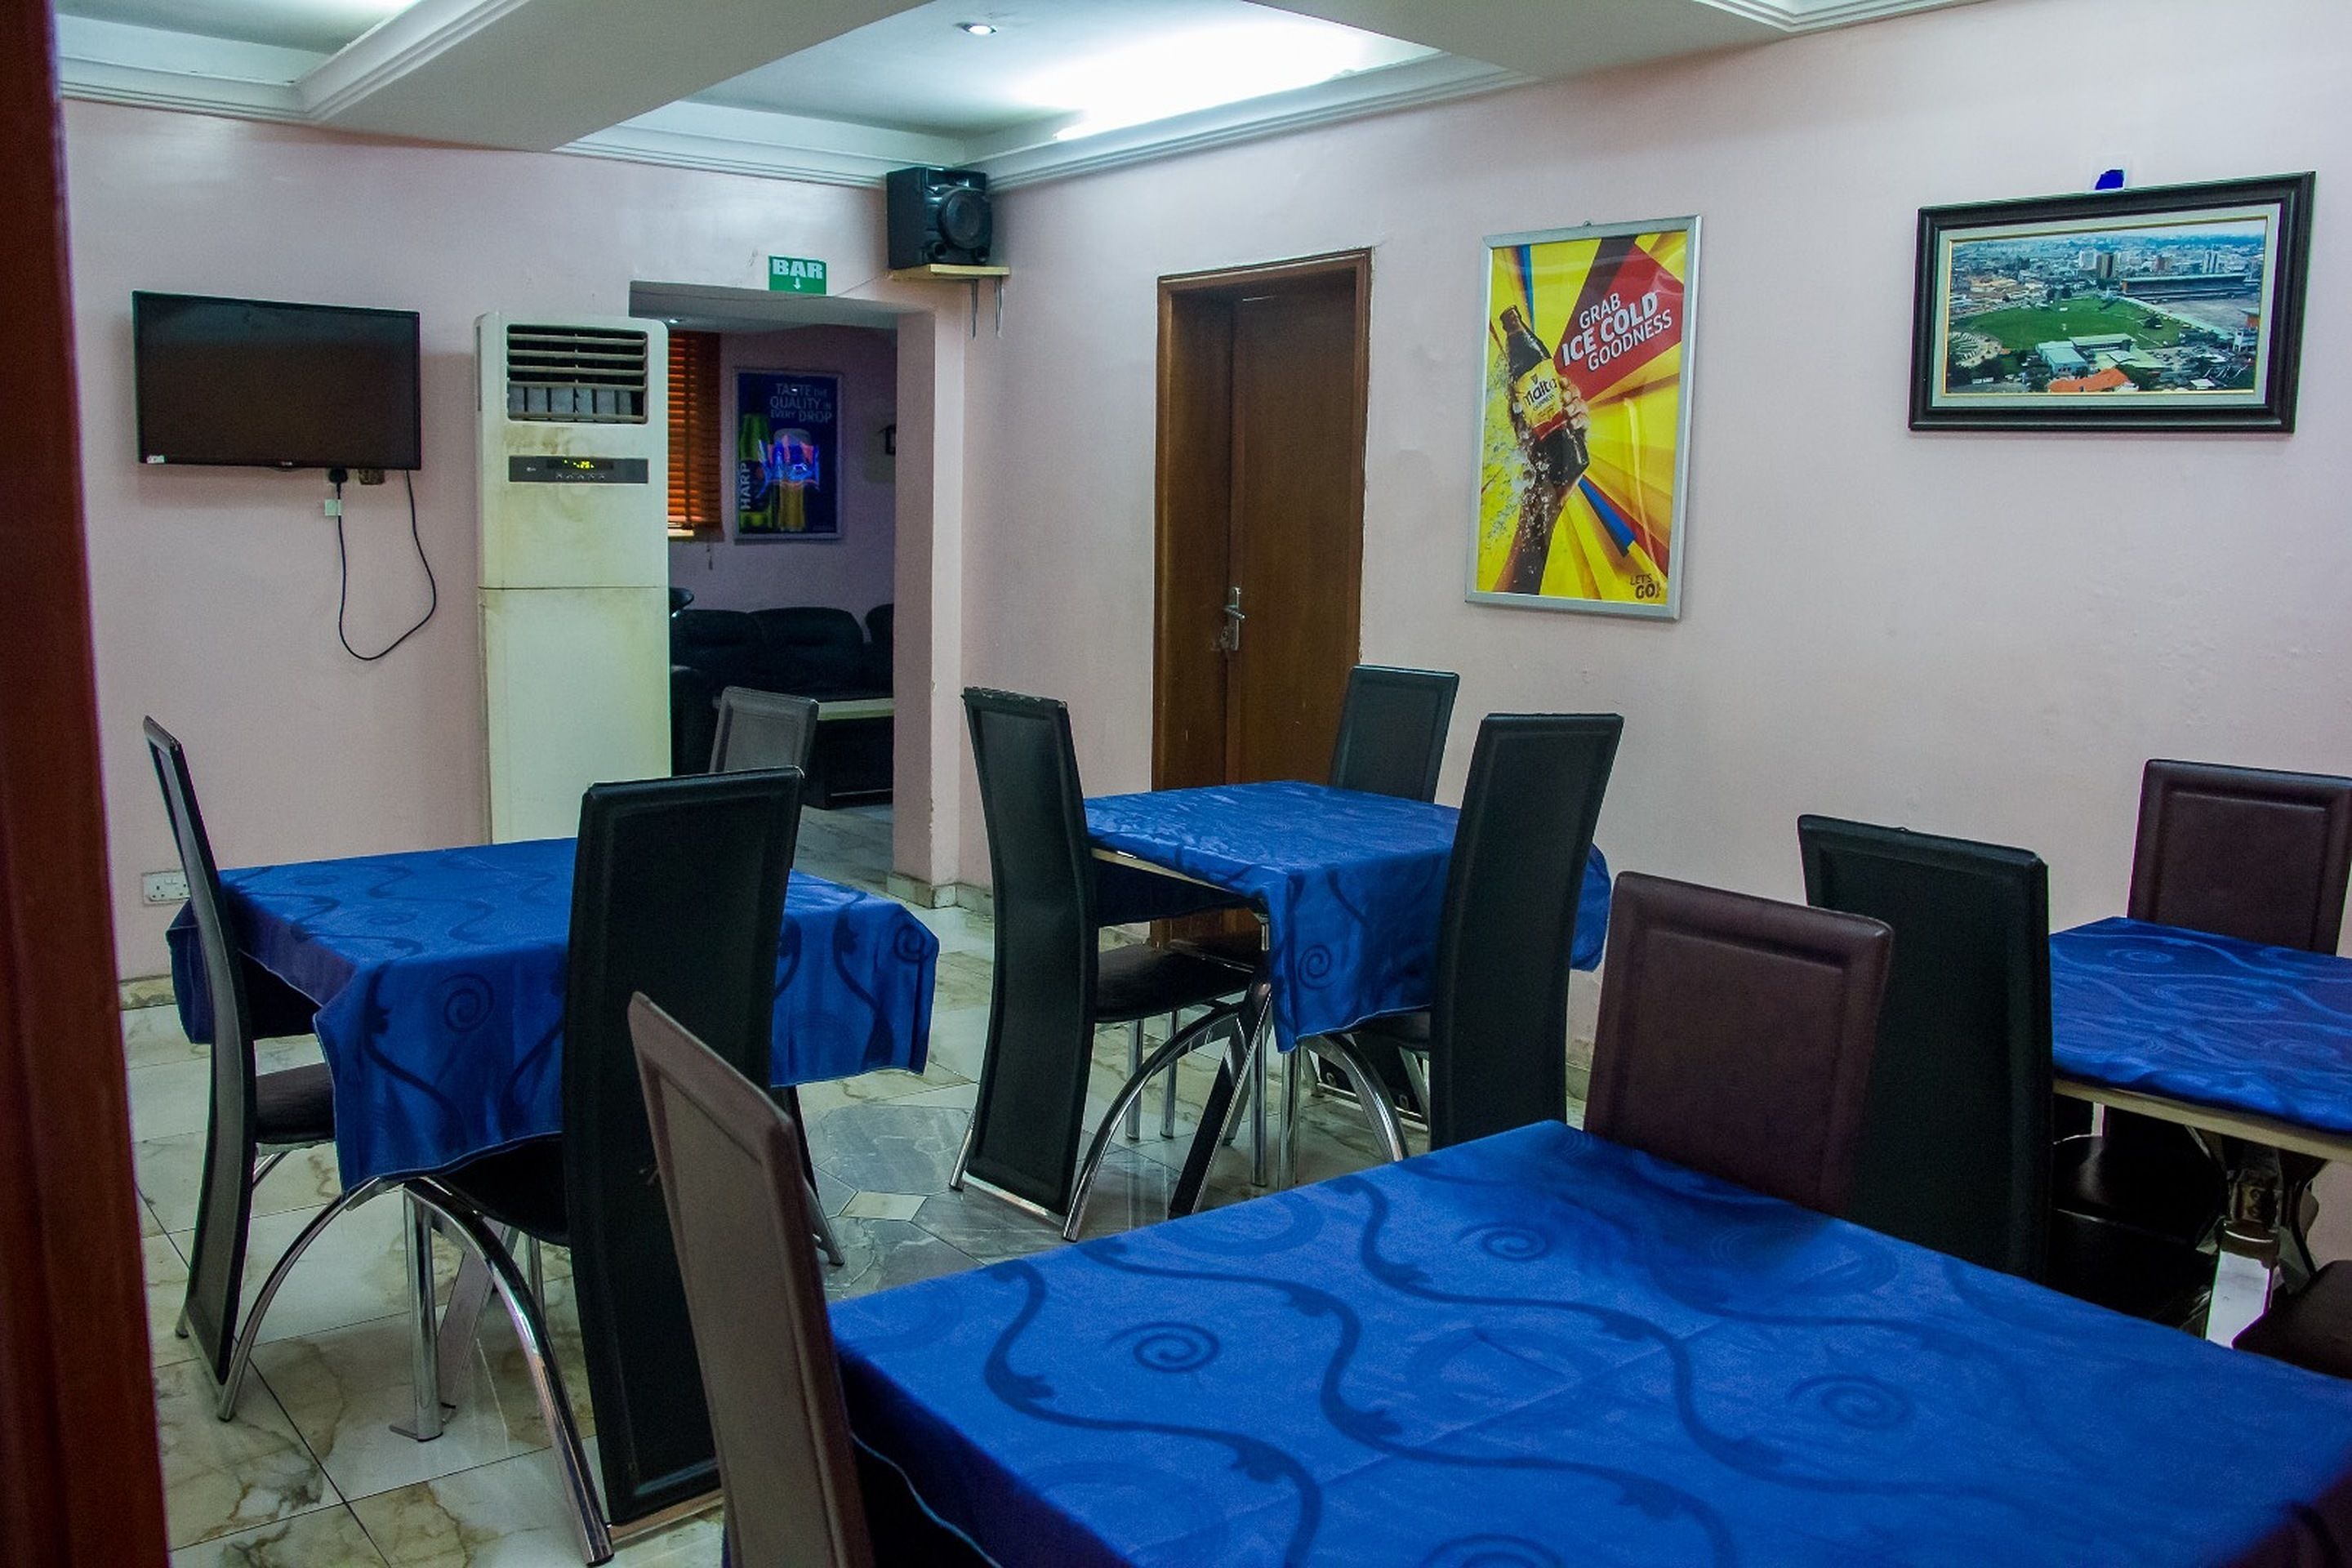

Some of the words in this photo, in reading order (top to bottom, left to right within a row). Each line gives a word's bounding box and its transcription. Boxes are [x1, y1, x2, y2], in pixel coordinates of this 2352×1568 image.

[773, 258, 823, 279] BAR
[1579, 292, 1621, 329] GRAB
[1561, 327, 1597, 367] ICE
[1601, 292, 1658, 342] COLD
[1588, 309, 1673, 372] GOODNESS
[770, 395, 822, 410] QUALITY
[776, 382, 812, 396] TASTE
[799, 410, 832, 423] DROP
[740, 462, 751, 510] HARP
